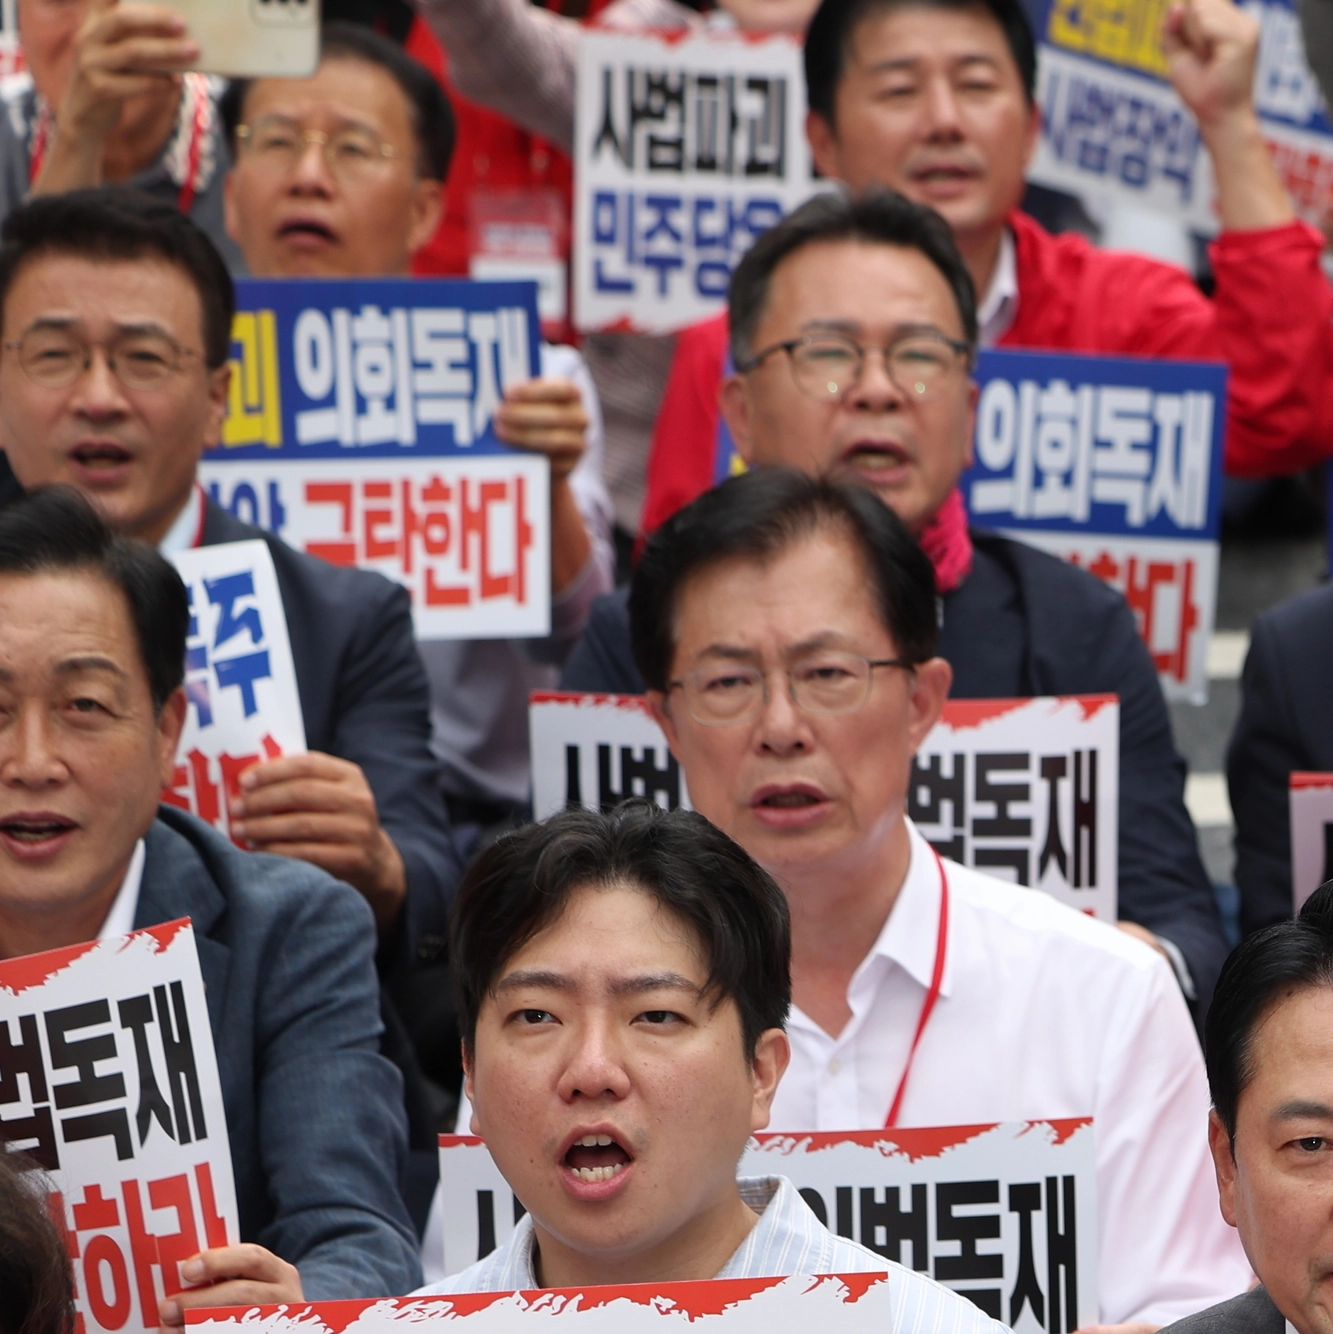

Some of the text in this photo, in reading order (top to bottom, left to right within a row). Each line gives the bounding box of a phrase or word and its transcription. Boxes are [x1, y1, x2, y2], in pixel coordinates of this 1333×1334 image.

[593, 66, 787, 176] 사법파괴
[293, 304, 531, 448] 의회독재
[971, 380, 1215, 529] 의회독재
